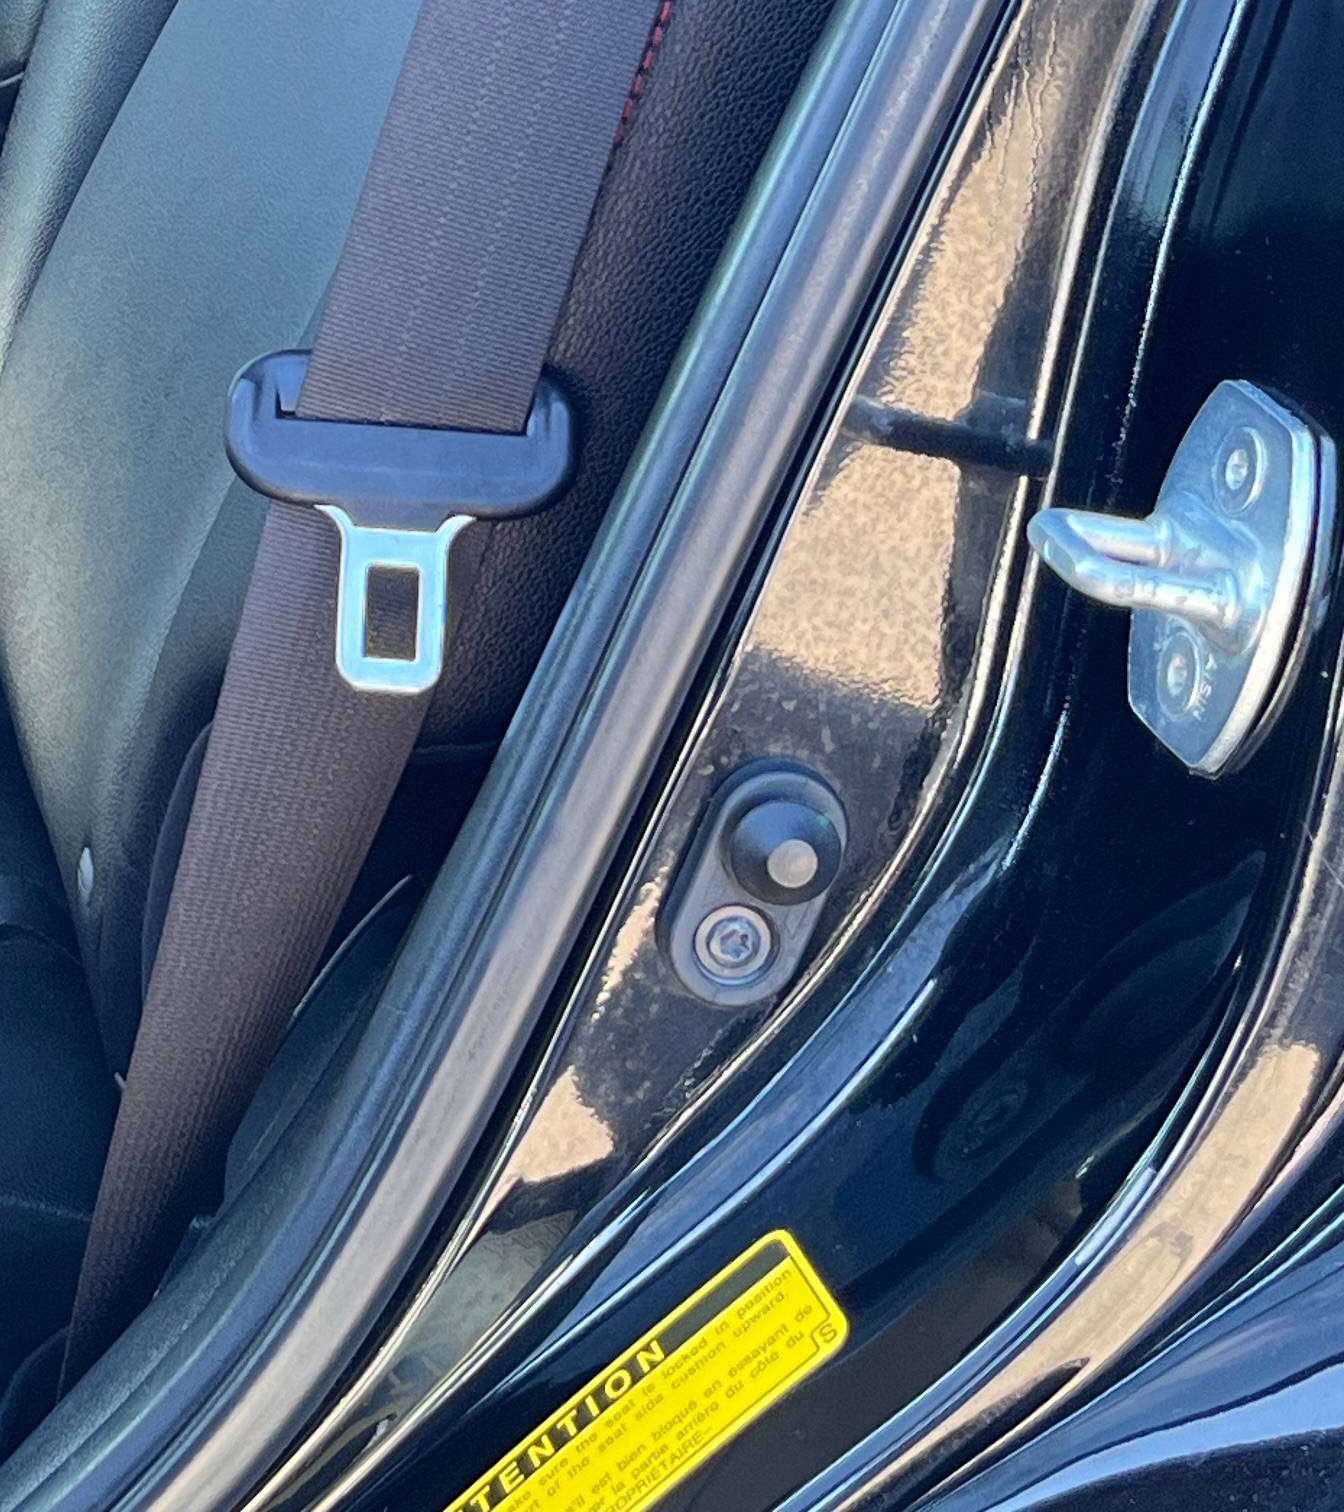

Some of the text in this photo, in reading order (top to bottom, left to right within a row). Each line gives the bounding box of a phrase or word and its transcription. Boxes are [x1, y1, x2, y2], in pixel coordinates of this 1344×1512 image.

[662, 1337, 708, 1379] locked
[714, 1319, 730, 1335] in
[736, 1268, 792, 1319] position
[794, 1304, 813, 1323] de
[819, 1323, 838, 1343] S
[670, 1341, 727, 1390] cushion
[725, 1380, 744, 1399] du
[785, 1330, 805, 1349] du
[460, 1339, 665, 1512] TENTION
